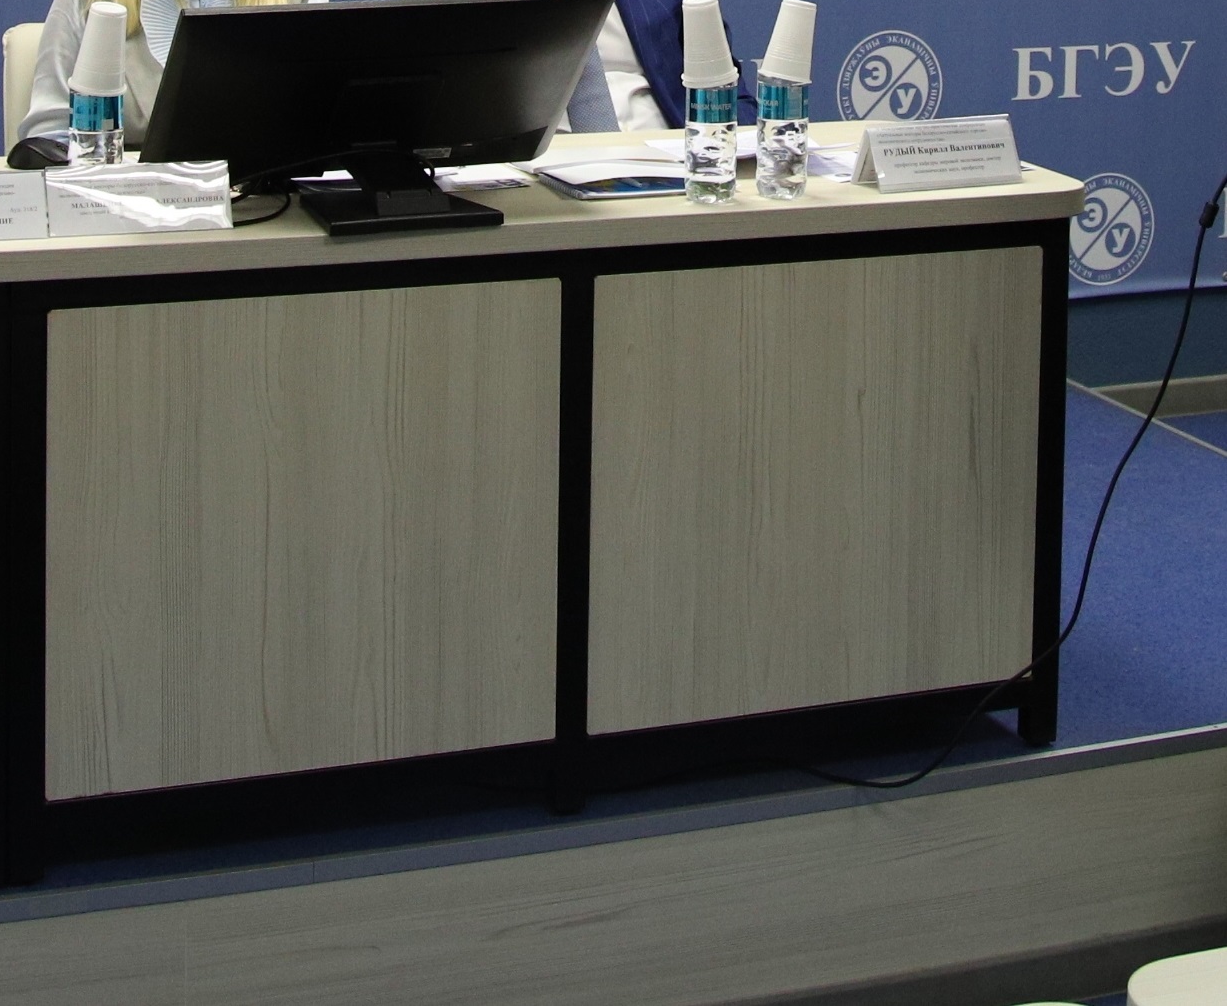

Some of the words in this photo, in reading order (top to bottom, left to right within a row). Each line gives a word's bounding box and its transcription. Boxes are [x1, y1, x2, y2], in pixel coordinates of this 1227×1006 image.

[1012, 40, 1196, 101] БГЭУ
[884, 146, 916, 156] РУДЫЙ
[918, 146, 948, 156] Кирилл
[950, 142, 1005, 152] Валентинович
